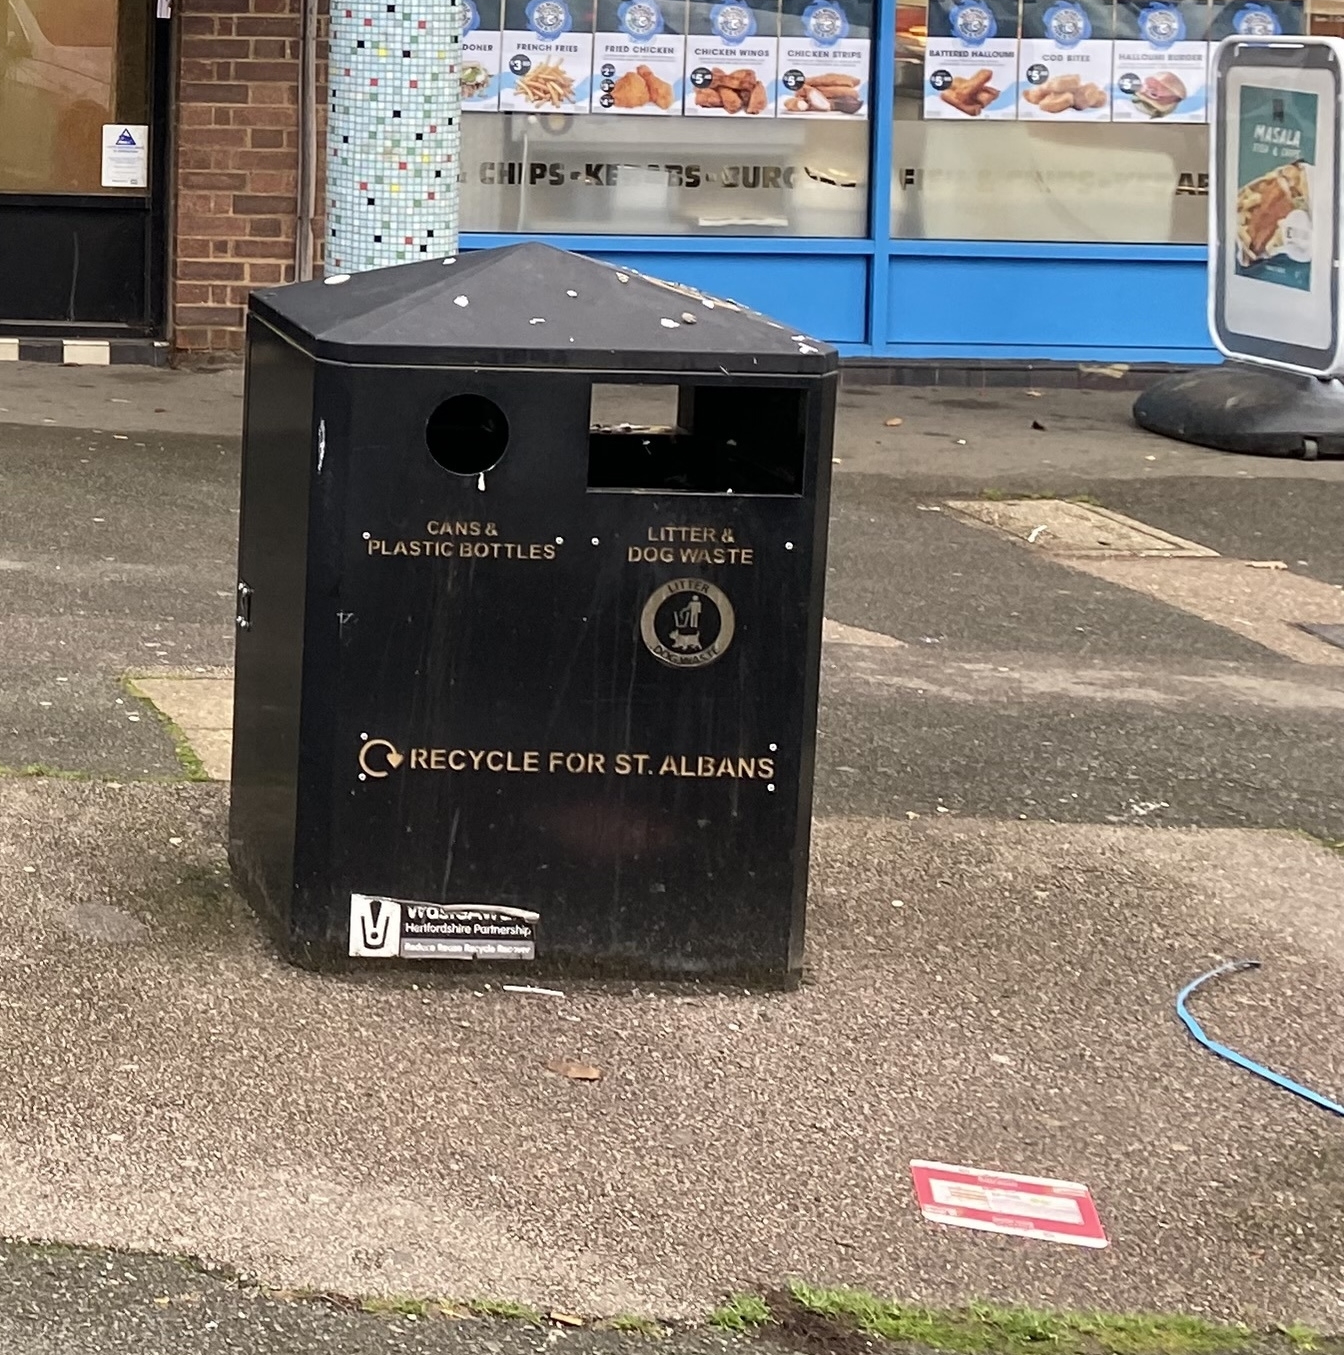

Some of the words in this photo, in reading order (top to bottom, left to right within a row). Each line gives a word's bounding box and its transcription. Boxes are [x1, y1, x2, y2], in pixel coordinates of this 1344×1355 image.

[462, 44, 493, 52] DONER
[516, 43, 552, 52] FRENCH
[555, 44, 578, 53] FRIES
[605, 45, 630, 53] FRIED
[632, 45, 674, 54] CHICKEN
[694, 48, 736, 56] CHICKEN
[739, 49, 770, 57] WINGS
[787, 50, 829, 58] CHICKEN
[832, 51, 862, 59] STRIPS
[929, 50, 969, 58] BATTERED
[971, 50, 1015, 58] HALLOUMI
[1254, 125, 1301, 147] MASALA
[479, 161, 565, 186] CHIPS
[427, 520, 480, 536] CANS
[485, 522, 499, 536] &
[648, 526, 716, 542] LITTER
[721, 527, 735, 543] &
[368, 539, 453, 557] PLASTIC
[459, 542, 556, 560] BOTTLES
[628, 546, 673, 562] DOG
[680, 548, 754, 565] WASTE
[667, 579, 710, 594] LITTER
[653, 645, 678, 663] DOG
[679, 647, 721, 664] WASTE
[410, 748, 540, 772] RECYCLE
[549, 751, 606, 774] FOR
[614, 753, 653, 776] ST.
[658, 754, 775, 779] ALBANS
[405, 922, 471, 935] Hertfordshire
[473, 924, 532, 938] Partnership
